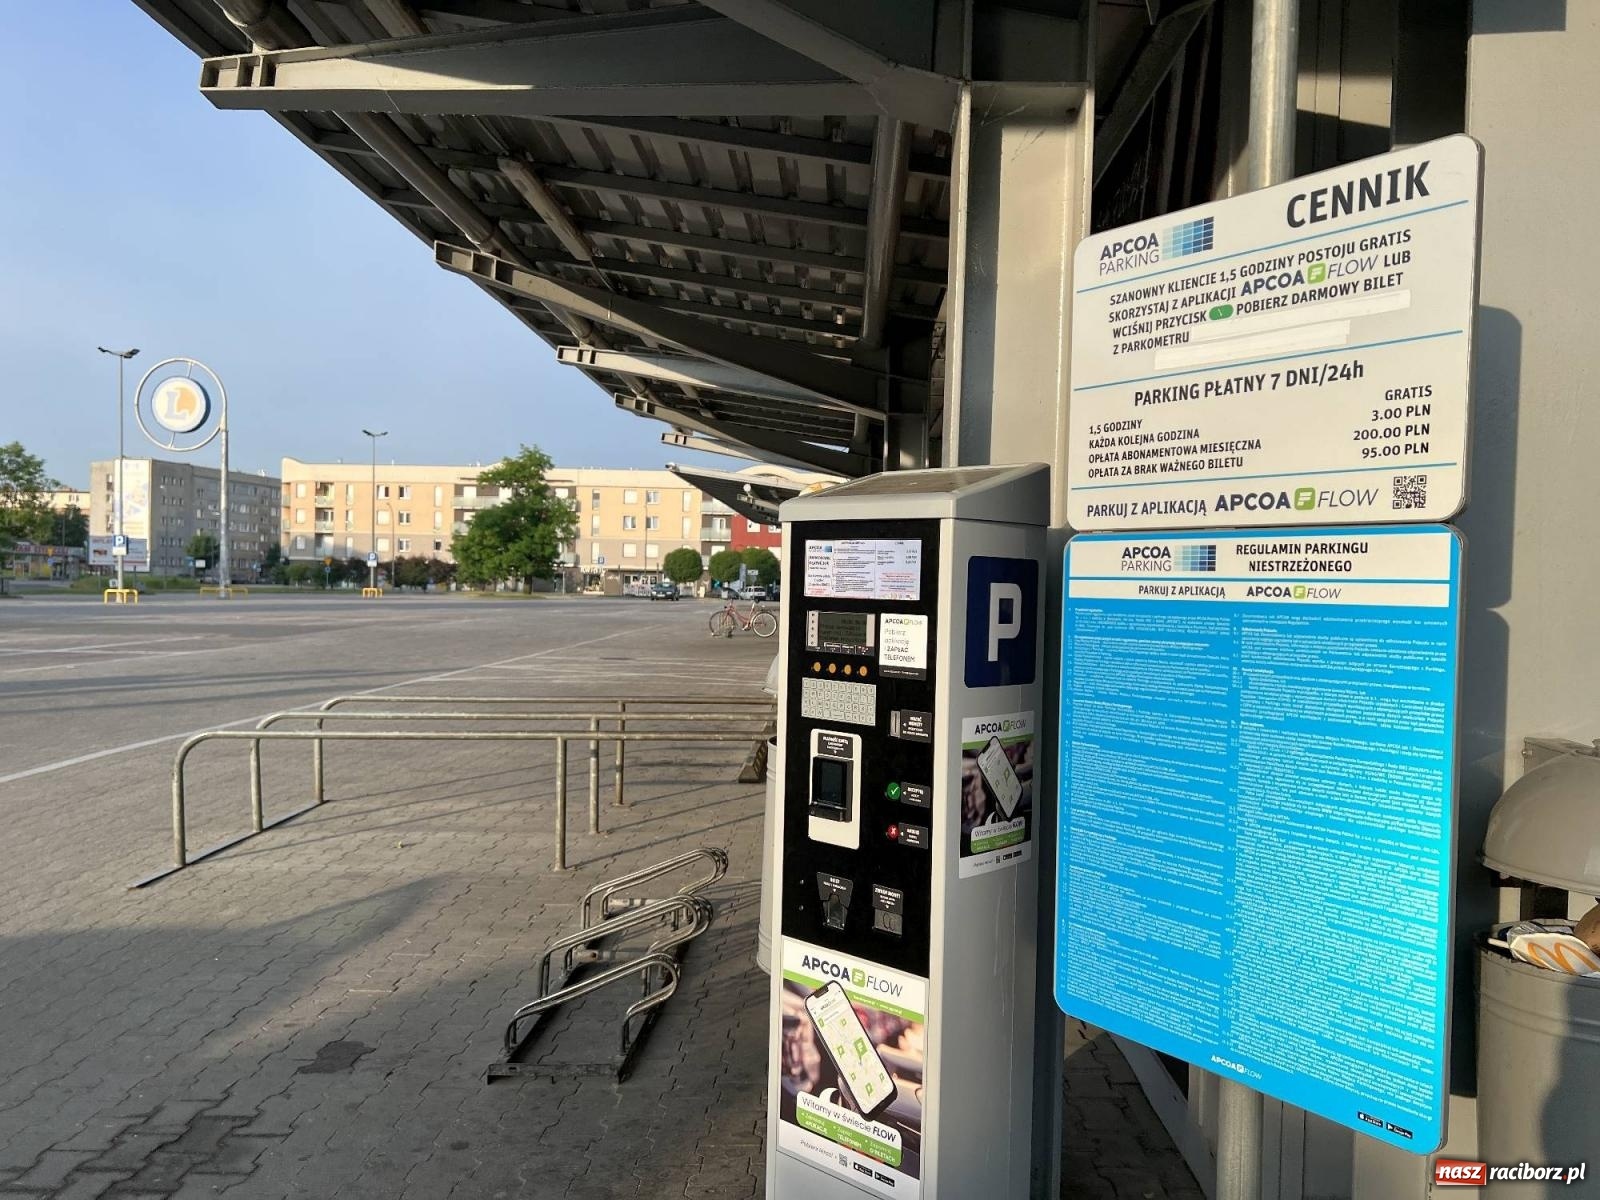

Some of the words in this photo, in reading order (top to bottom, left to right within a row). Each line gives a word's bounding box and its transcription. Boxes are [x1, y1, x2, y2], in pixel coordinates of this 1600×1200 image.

[1287, 160, 1430, 228] CENNIK
[1100, 232, 1159, 261] APCOA
[1100, 249, 1160, 276] PARKING
[1110, 284, 1165, 306] SZANOWNY
[1168, 272, 1217, 293] KLIENCIE
[1219, 269, 1236, 282] 1,5
[1240, 255, 1295, 278] GODZINY
[1298, 242, 1355, 265] POSTOJU
[1359, 229, 1411, 251] GRATIS
[1109, 302, 1169, 323] SKORZYSTAJ
[1172, 299, 1178, 310] Z
[1180, 287, 1236, 309] APLIKACJI
[1241, 269, 1305, 296] APCOA
[1328, 255, 1379, 279] FLOW
[1384, 250, 1411, 268] LUB
[1113, 320, 1152, 339] WCIŚNIJ
[1155, 310, 1207, 330] PRZYCISK
[1237, 295, 1288, 315] POBIERZ
[1292, 280, 1360, 305] DARMOWY
[1364, 272, 1404, 292] BILET
[1113, 344, 1119, 355] Z
[1121, 331, 1190, 354] PARKOMETRU
[1134, 383, 1200, 406] PARKING
[1204, 373, 1266, 398] PŁATNY
[1271, 373, 1281, 390] 7
[1286, 360, 1364, 387] DNI/24h
[1385, 385, 1432, 400] GRATIS
[1372, 407, 1402, 421] 3.00
[1406, 404, 1431, 417] PLN
[1089, 424, 1101, 436] 1,5
[1103, 419, 1143, 433] GODZINY
[1353, 426, 1401, 440] 200.00
[1405, 423, 1430, 436] PLN
[1089, 436, 1116, 449] KAŻDA
[1118, 433, 1154, 446] KOLEJNA
[1157, 428, 1200, 442] GODZINA
[1088, 452, 1119, 463] OPŁATA
[1121, 445, 1198, 461] ABONAMENTOWA
[1200, 438, 1261, 454] MIESIĘCZNA
[1362, 445, 1401, 459] 95.00
[1405, 442, 1429, 455] PLN
[1088, 466, 1119, 478] OPŁATA
[1121, 466, 1132, 476] ZA
[1134, 463, 1157, 475] BRAK
[1160, 459, 1205, 473] WAŻNEGO
[1208, 457, 1244, 469] BILETU
[1087, 503, 1128, 518] PARKUJ
[1131, 503, 1138, 515] Z
[1141, 499, 1207, 516] APLIKACJĄ
[1214, 491, 1291, 512] APCOA
[1318, 488, 1379, 508] FLOW
[1121, 546, 1171, 559] APCOA
[1236, 543, 1301, 555] REGULAMIN
[1305, 542, 1369, 554] PARKINGU
[1121, 560, 1172, 572] PARKING
[1249, 557, 1353, 572] NIESTRZEŻONEGO
[1138, 585, 1169, 597] PARKUJ
[1171, 586, 1176, 595] Z
[1178, 586, 1226, 598] APLIKACJĄ
[1246, 586, 1292, 598] APCOA
[1306, 588, 1342, 599] FLOW
[988, 582, 1022, 662] P
[975, 721, 1002, 735] APCOA
[801, 954, 851, 982] APCOA
[866, 975, 904, 998] FLOW
[1211, 1055, 1237, 1070] APCOA
[801, 1096, 831, 1117] Witamy
[833, 1111, 840, 1119] w
[873, 1126, 897, 1142] FLOW
